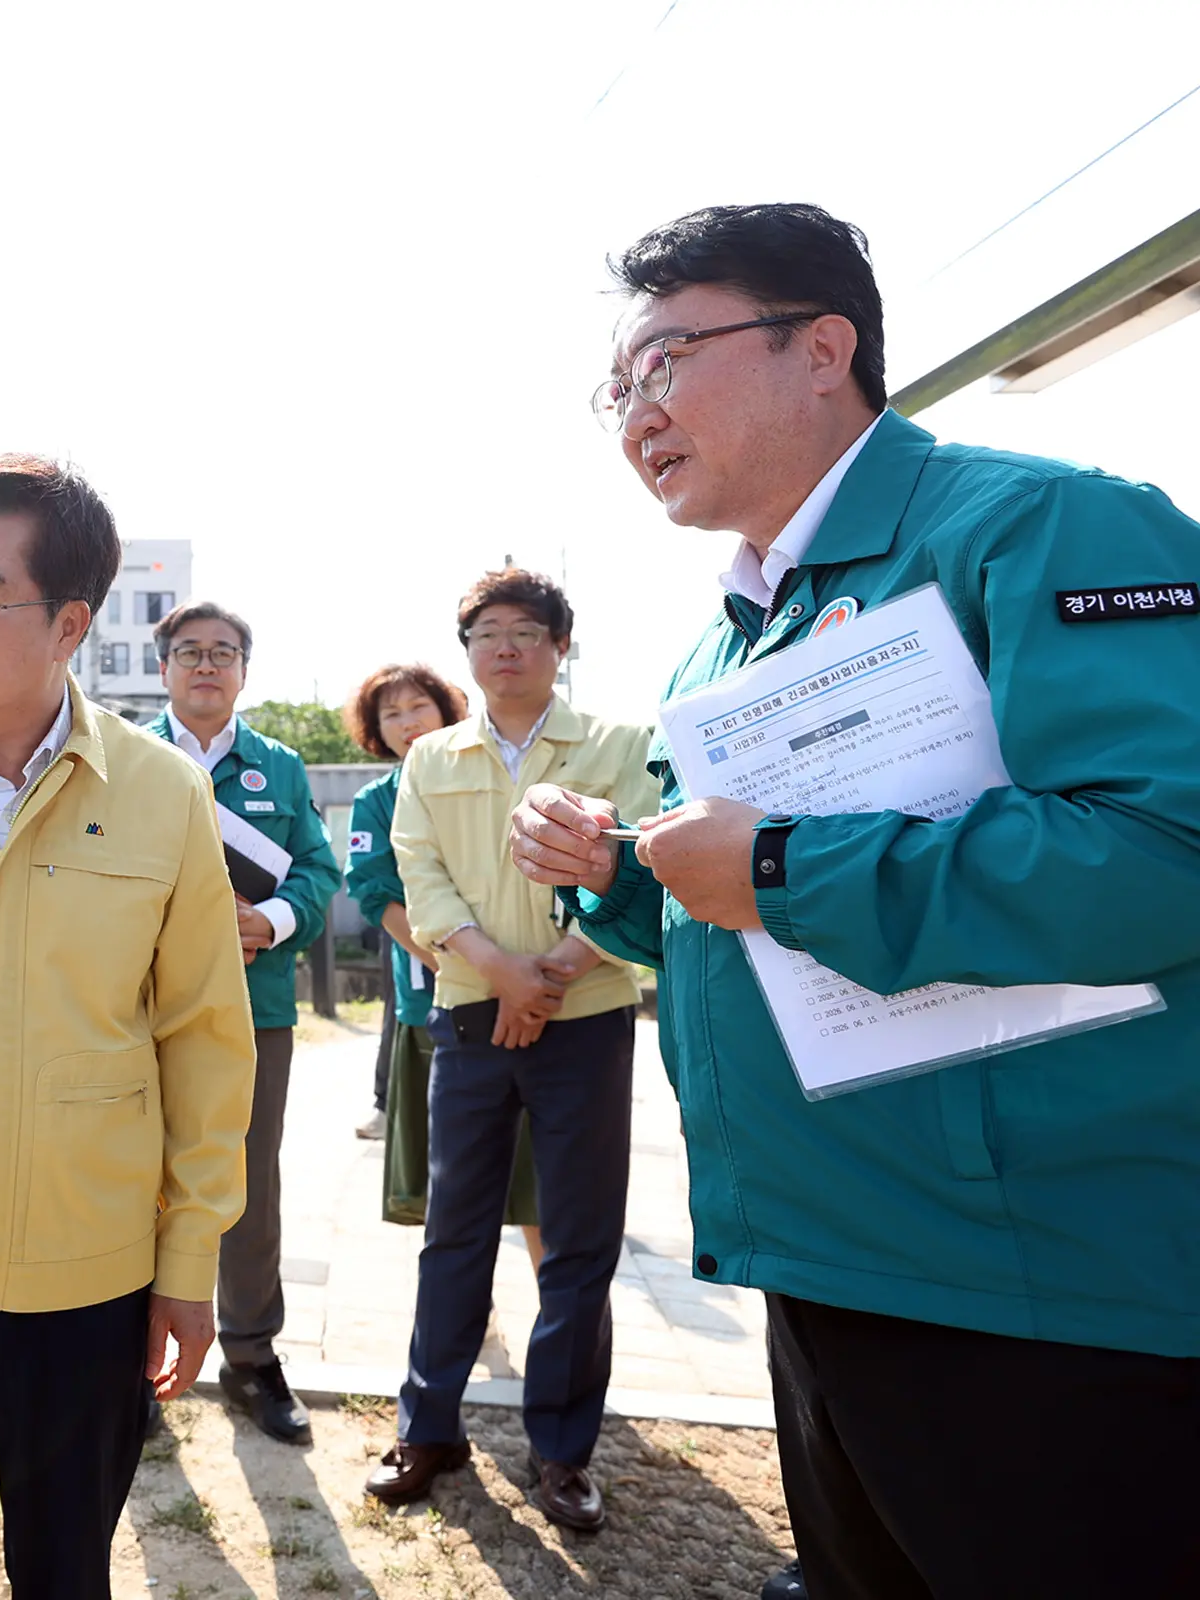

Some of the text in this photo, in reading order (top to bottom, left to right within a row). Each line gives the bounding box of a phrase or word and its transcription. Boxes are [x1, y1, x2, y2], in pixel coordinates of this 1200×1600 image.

[1065, 589, 1194, 614] 경기 이천시청
[742, 697, 783, 721] 인명피해
[733, 732, 765, 751] 사업개요
[889, 997, 947, 1018] 자동수위계측기
